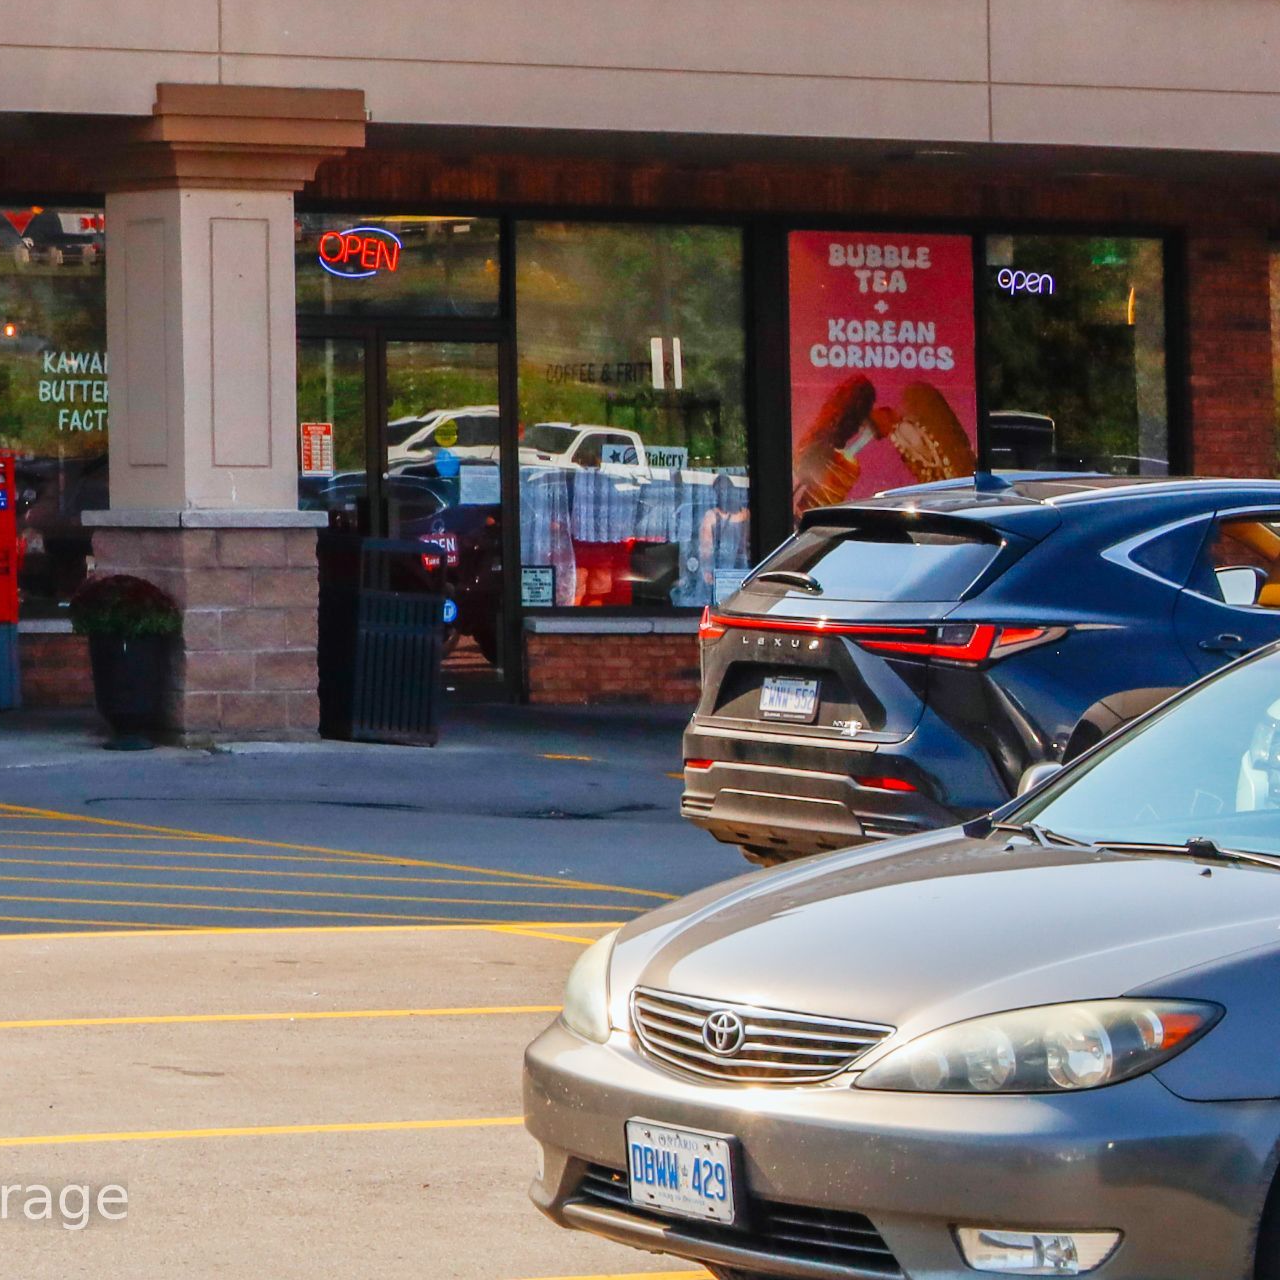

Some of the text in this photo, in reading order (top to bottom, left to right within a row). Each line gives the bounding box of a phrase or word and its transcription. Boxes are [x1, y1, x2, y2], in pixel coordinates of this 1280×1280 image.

[318, 230, 400, 273] OPEN
[828, 243, 932, 269] BUBBLE
[854, 270, 908, 294] TEA
[828, 318, 936, 344] KOREAN
[810, 344, 955, 370] CORNDOGS
[546, 363, 595, 383] COFFEE
[601, 363, 611, 382] &
[59, 408, 108, 431] FACT
[632, 1143, 727, 1201] DBWW 429
